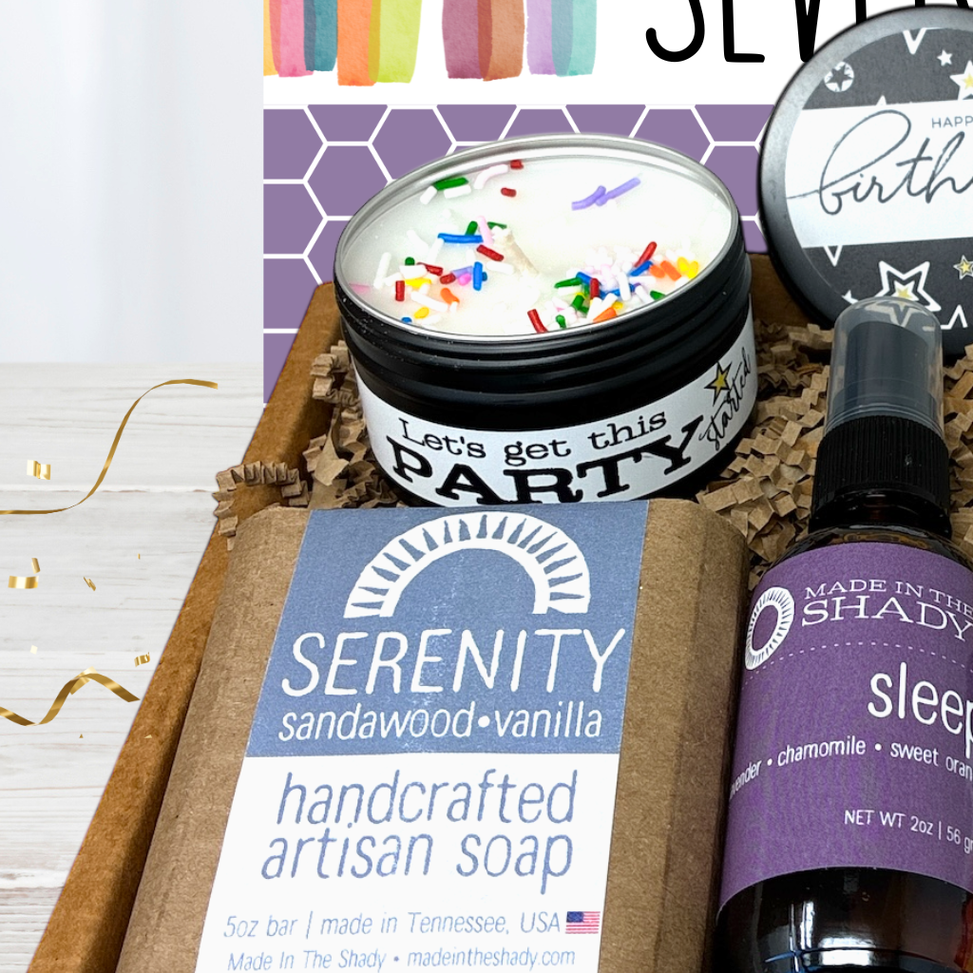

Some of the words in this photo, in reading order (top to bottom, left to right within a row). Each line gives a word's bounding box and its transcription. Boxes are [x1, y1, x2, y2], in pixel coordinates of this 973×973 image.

[699, 346, 752, 451] started
[386, 414, 704, 505] PARTY
[397, 417, 487, 459] Let's
[503, 437, 572, 467] get
[587, 410, 667, 451] this
[804, 578, 888, 601] MADE
[895, 580, 924, 599] IN
[281, 627, 626, 698] SERENITY
[777, 734, 867, 767] chamomile
[889, 740, 940, 766] sweet
[275, 768, 578, 826] handcrafted
[844, 808, 876, 826] NET
[879, 810, 907, 829] WT
[910, 815, 934, 836] 2oz
[946, 825, 962, 846] 56
[260, 821, 434, 880] artisan
[455, 832, 574, 895] soap
[223, 915, 260, 938] 5oz
[265, 914, 299, 937] bar
[320, 912, 373, 935] made
[380, 911, 399, 933] in
[407, 911, 510, 936] Tennessee,
[519, 911, 561, 933] USA
[226, 952, 273, 972] Made
[278, 950, 296, 970] In
[302, 949, 333, 970] The
[337, 947, 388, 973] Shady
[406, 946, 577, 973] madeintheshady.com
